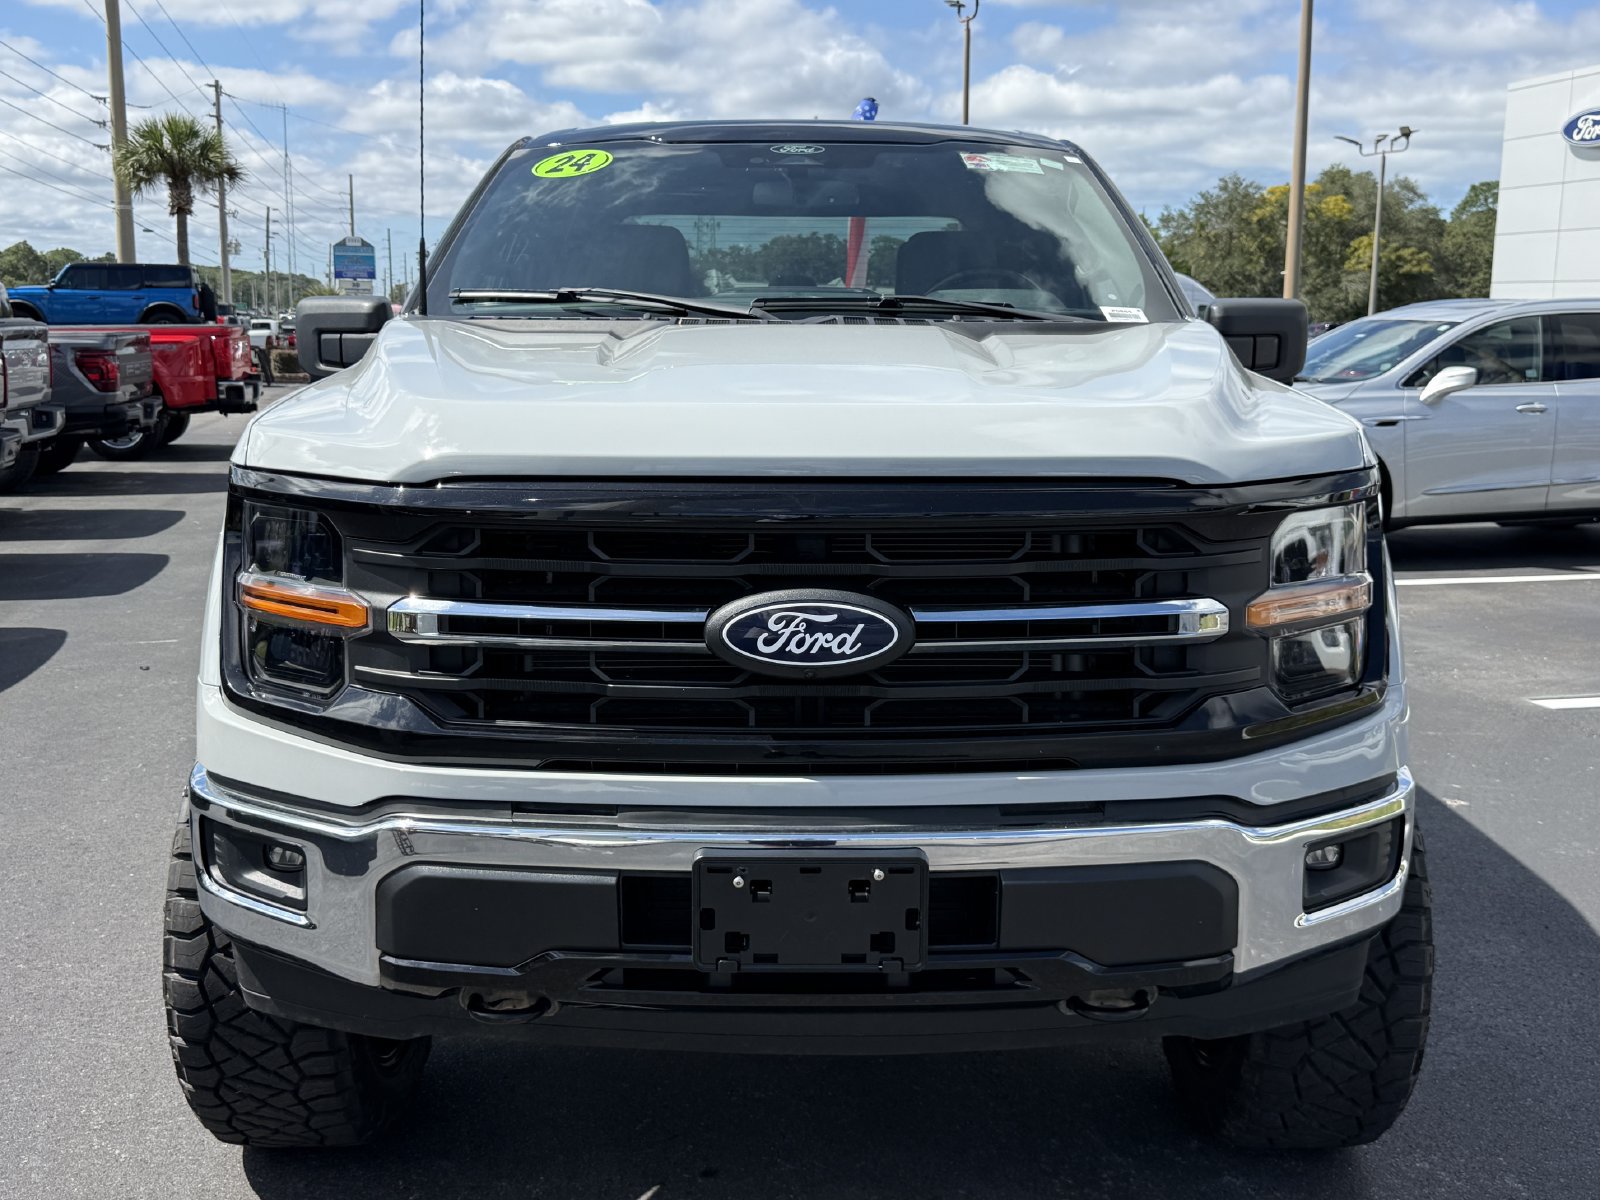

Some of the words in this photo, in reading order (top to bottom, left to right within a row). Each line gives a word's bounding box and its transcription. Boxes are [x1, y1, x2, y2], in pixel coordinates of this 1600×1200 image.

[1573, 115, 1600, 140] For
[780, 145, 815, 153] Ford
[545, 153, 597, 173] 24
[757, 611, 864, 654] Ford
